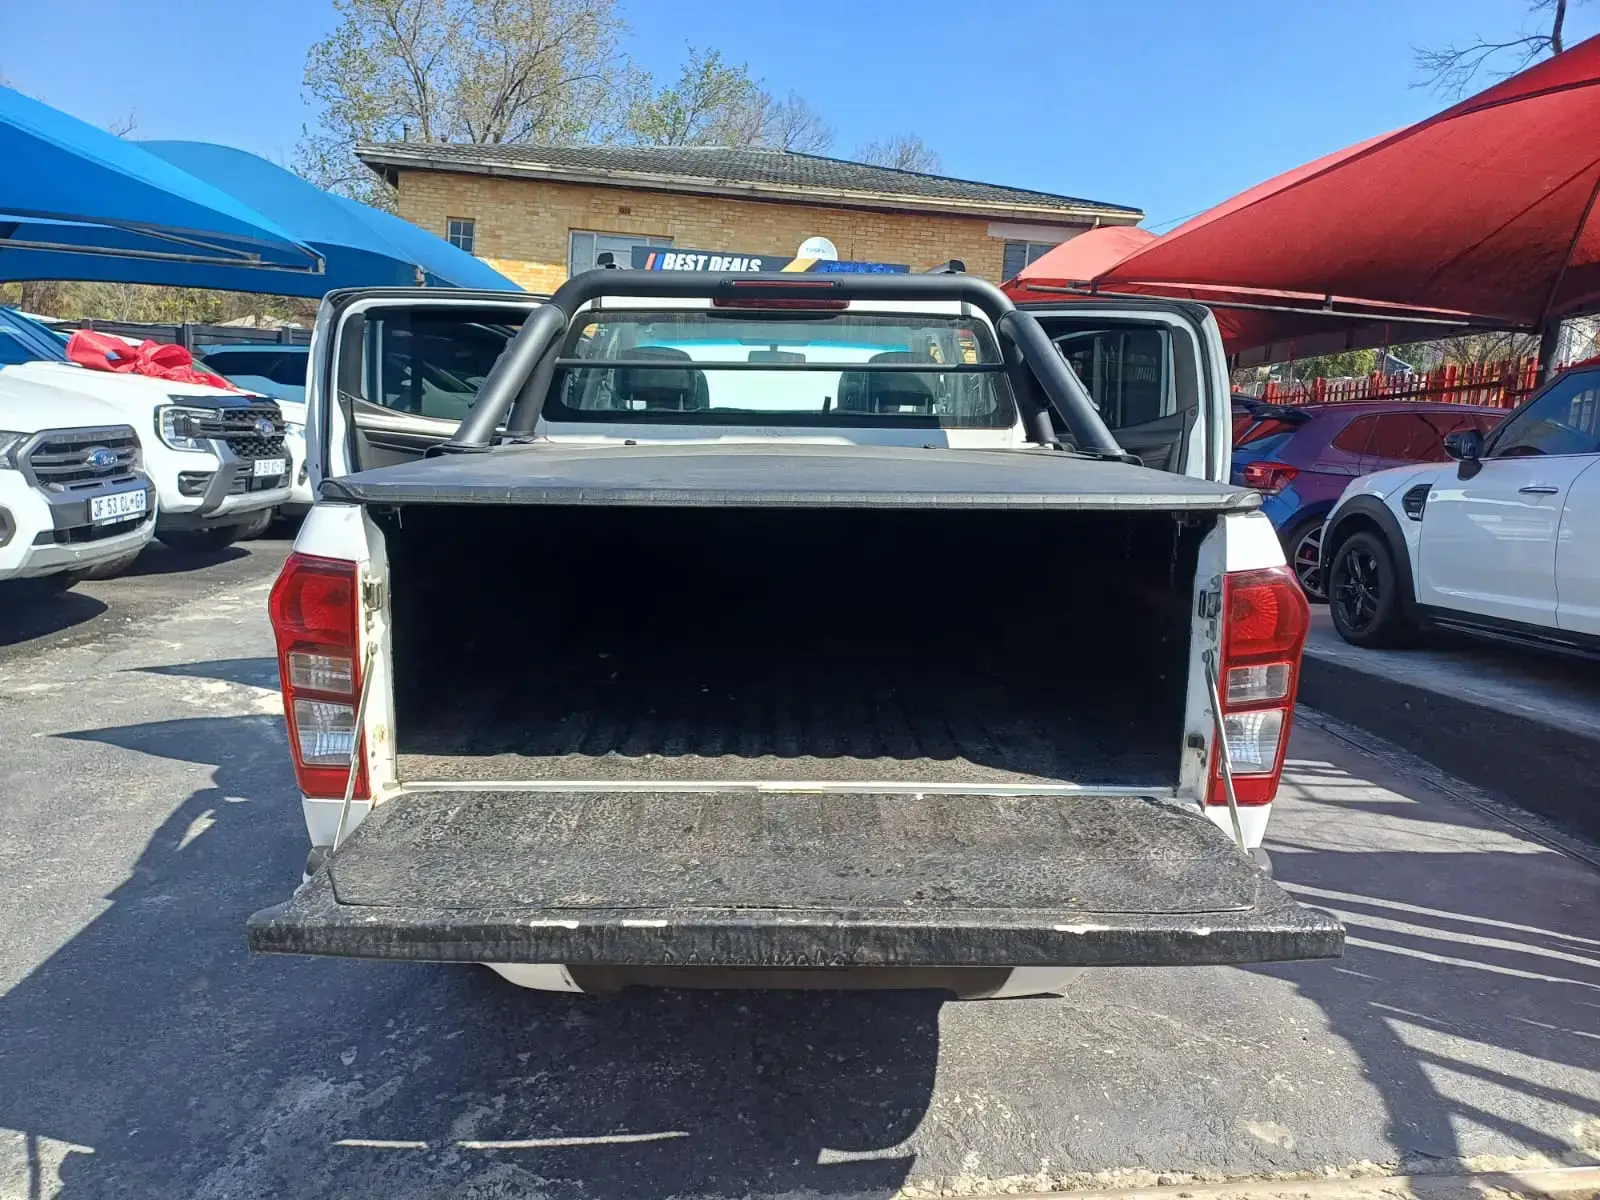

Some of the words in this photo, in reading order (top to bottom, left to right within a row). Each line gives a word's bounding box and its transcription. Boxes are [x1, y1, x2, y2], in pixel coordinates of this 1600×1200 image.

[662, 252, 708, 271] BEST
[708, 255, 762, 272] DEALS
[94, 500, 104, 518] JF
[107, 497, 118, 515] 53
[120, 496, 130, 512] CL
